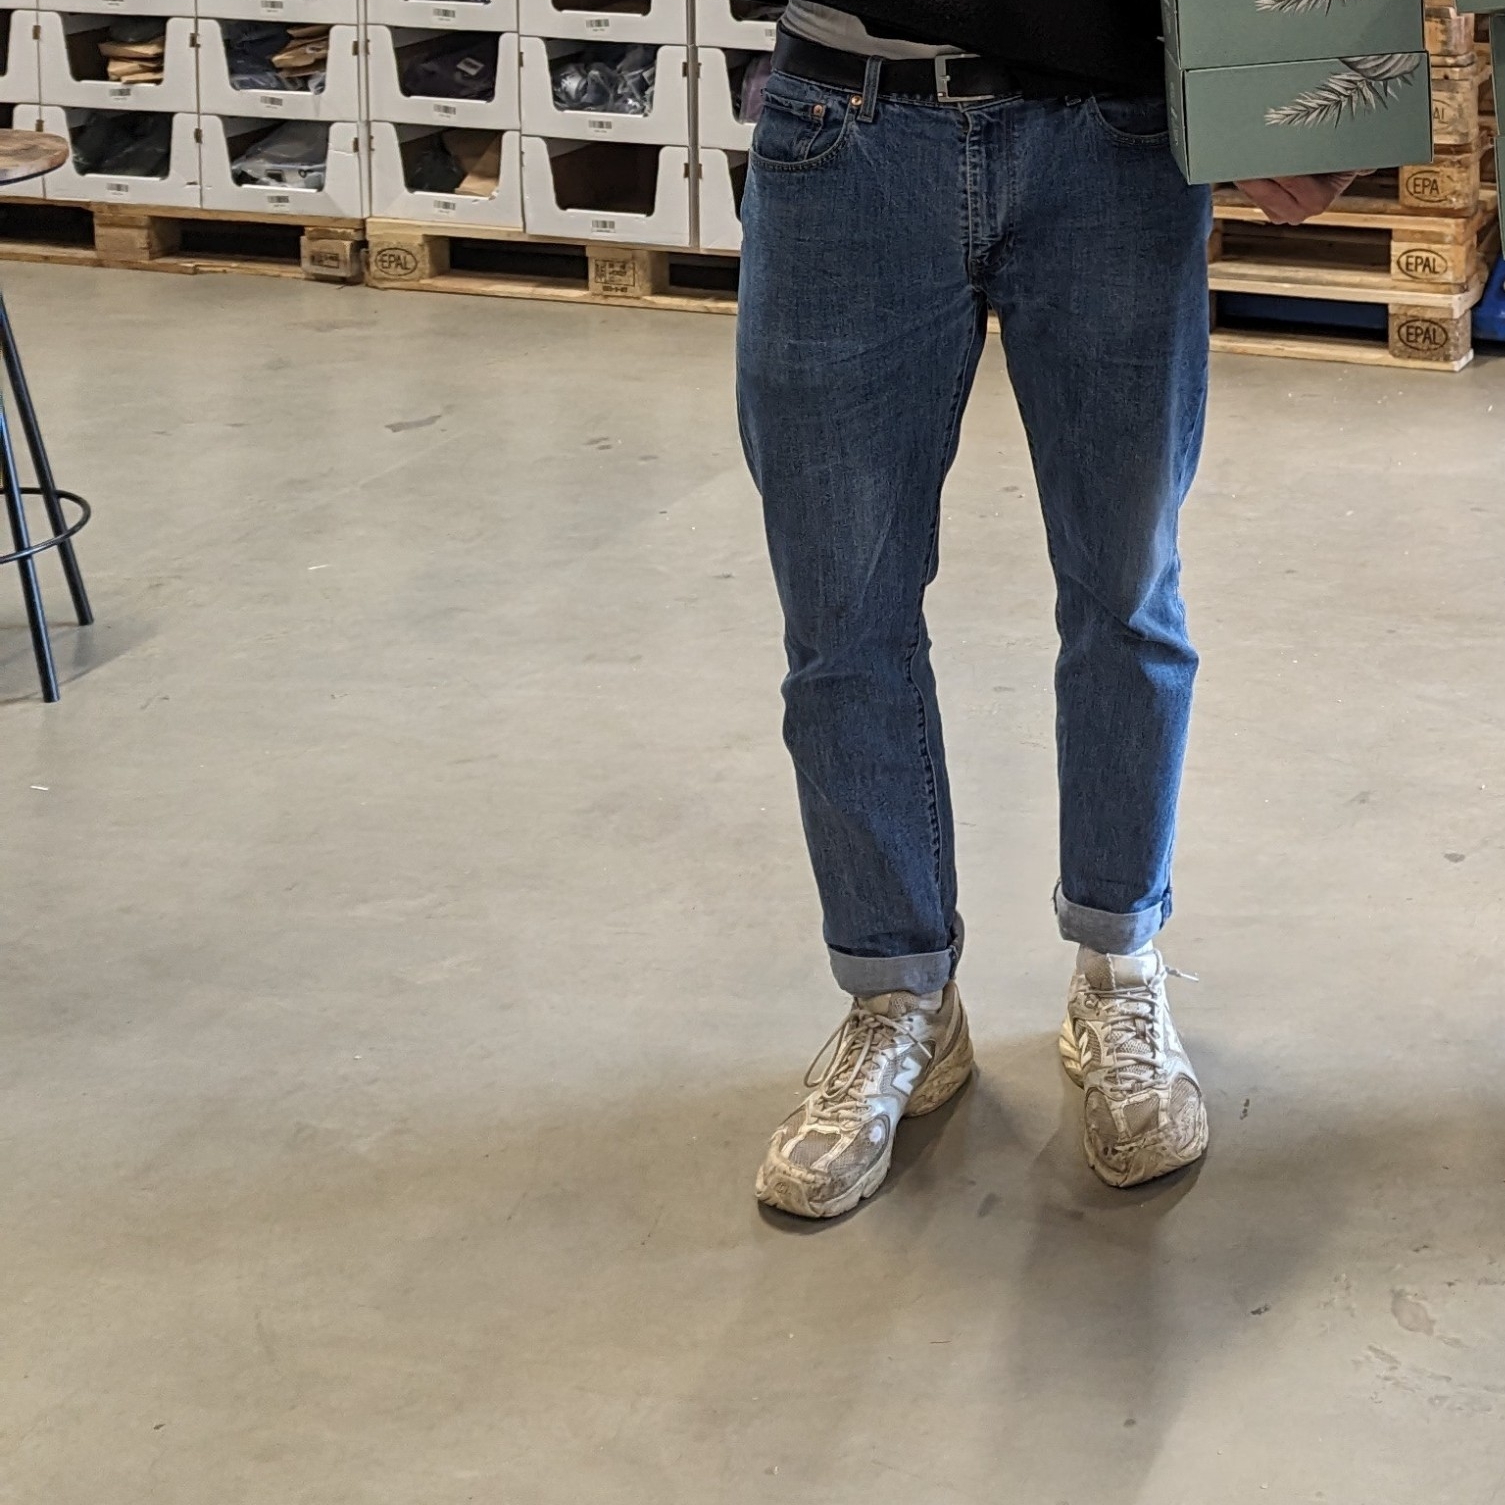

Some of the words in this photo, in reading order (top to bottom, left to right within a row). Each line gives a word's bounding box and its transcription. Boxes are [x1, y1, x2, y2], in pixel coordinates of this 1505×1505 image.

[1412, 177, 1440, 196] EPA
[379, 253, 411, 271] EPAL
[1405, 255, 1440, 275] EPAL
[1405, 325, 1440, 346] EPAL
